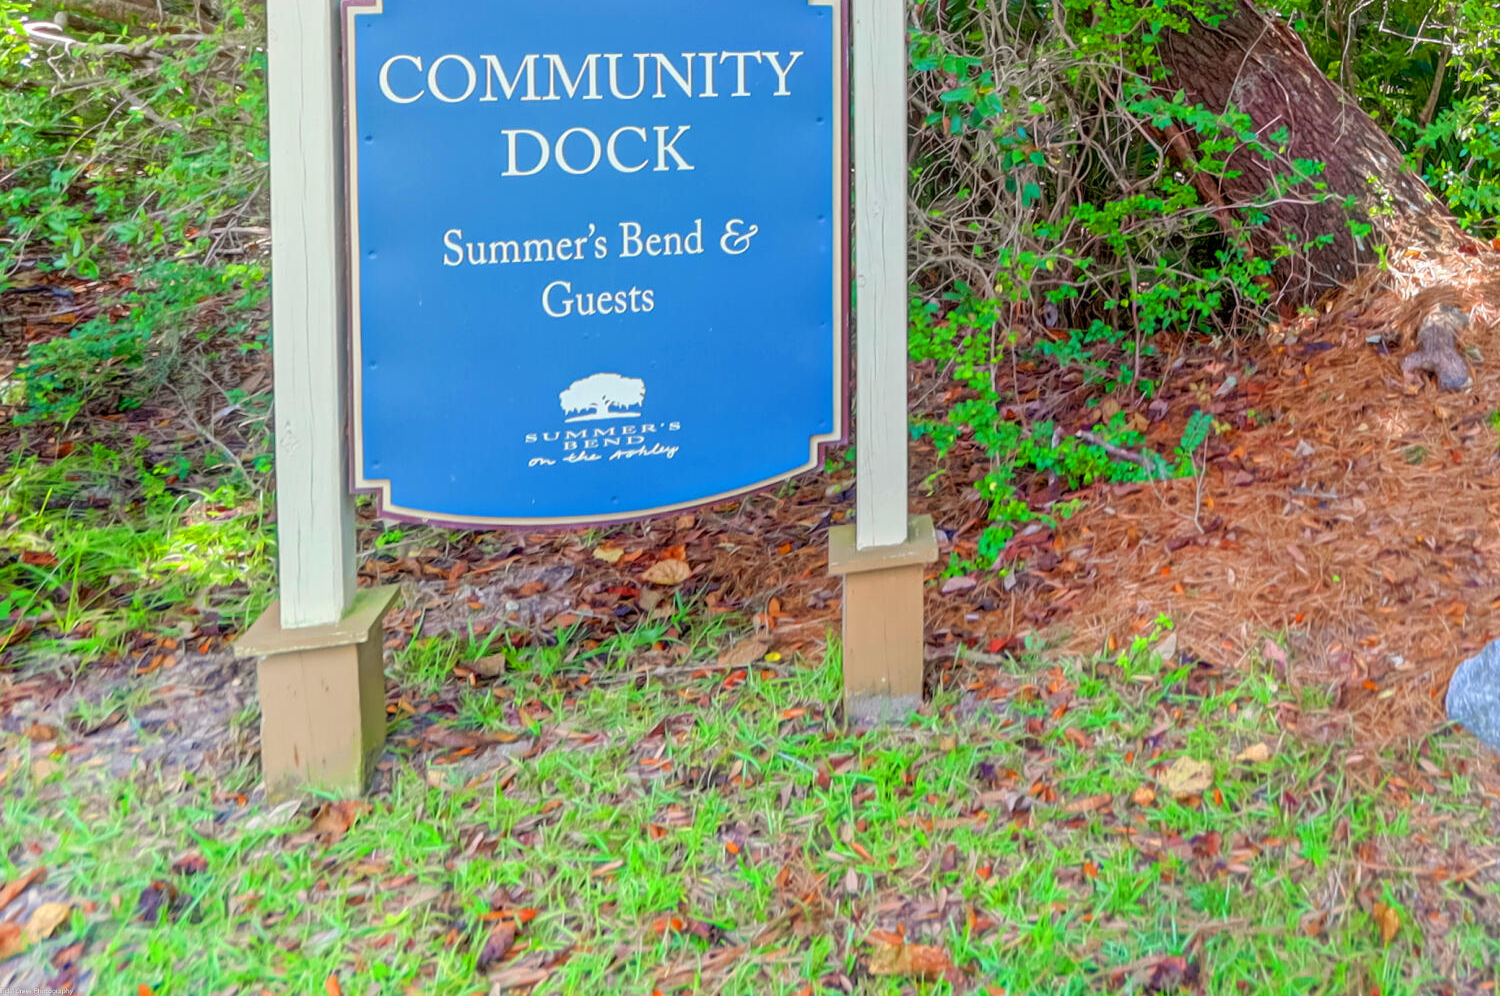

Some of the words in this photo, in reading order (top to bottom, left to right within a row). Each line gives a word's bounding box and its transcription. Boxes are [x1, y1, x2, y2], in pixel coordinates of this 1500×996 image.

[378, 50, 804, 105] COMMUNITY
[500, 124, 695, 177] DOCK
[443, 222, 608, 267] Summer's
[618, 218, 705, 258] Bend
[719, 218, 759, 256] &
[541, 280, 655, 318] Guests
[525, 421, 682, 444] SUMMER'S
[563, 435, 646, 451] BEND
[528, 457, 556, 467] on
[562, 450, 602, 463] the
